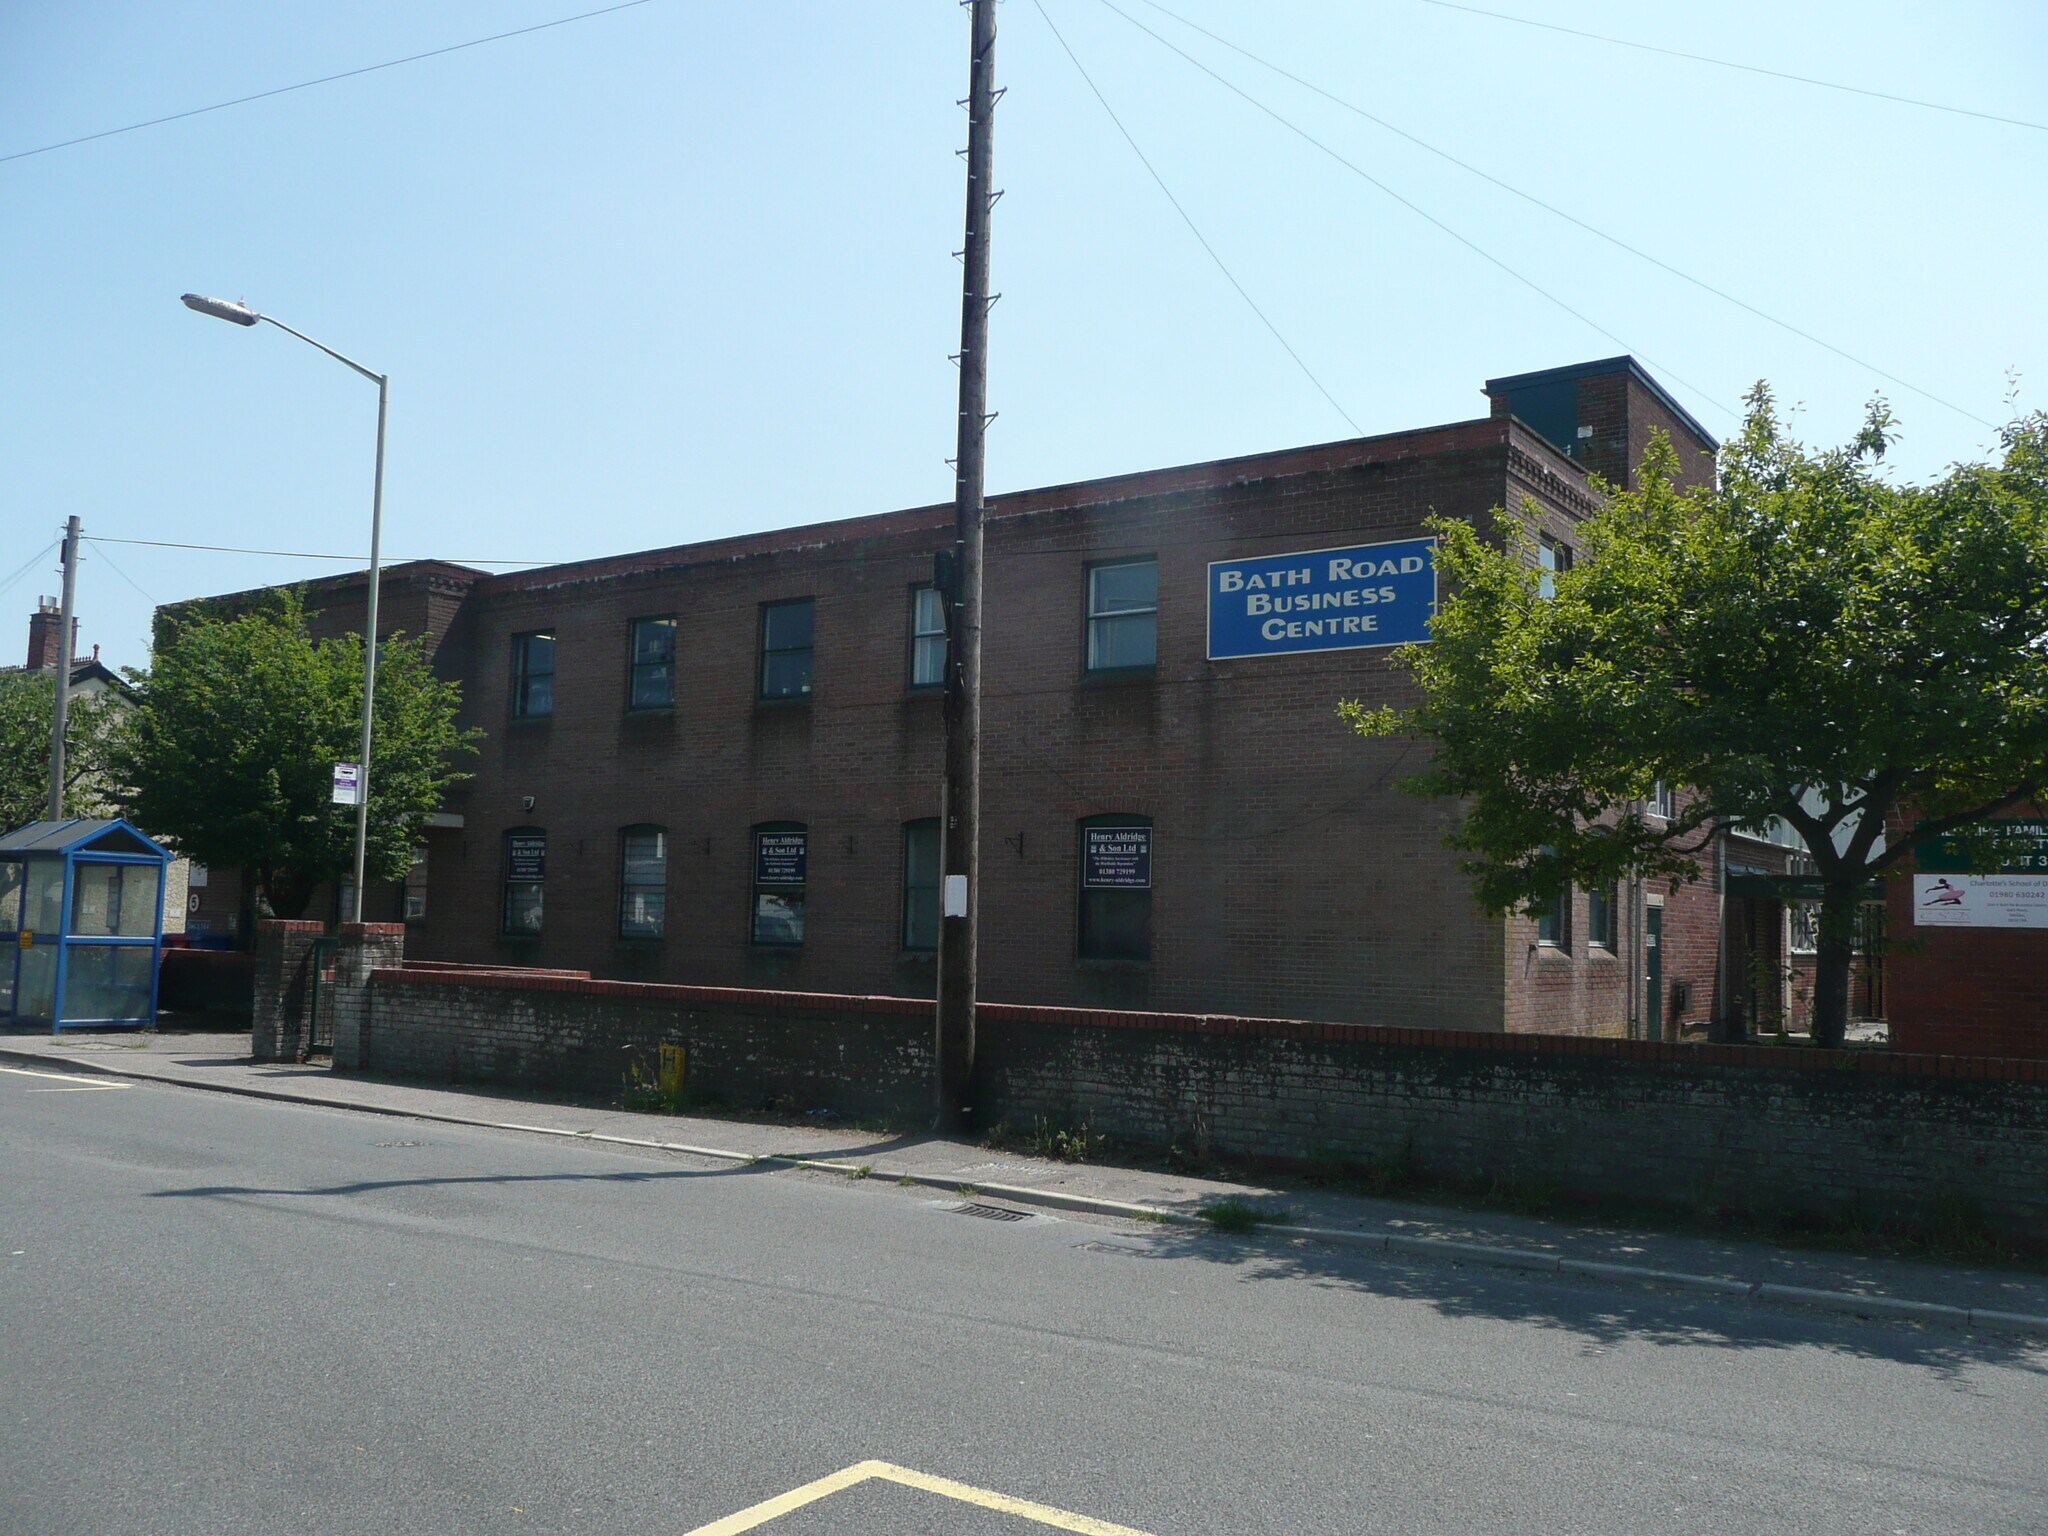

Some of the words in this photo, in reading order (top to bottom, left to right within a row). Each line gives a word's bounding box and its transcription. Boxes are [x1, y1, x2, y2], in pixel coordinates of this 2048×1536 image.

[1219, 567, 1311, 593] BATH
[1329, 556, 1424, 582] ROAD
[1247, 585, 1396, 616] BUSINESS
[1261, 614, 1378, 641] CENTRE
[1090, 832, 1113, 842] Henry
[1114, 832, 1147, 842] Aldridge
[1099, 844, 1107, 852] &
[1108, 844, 1122, 852] Son
[1123, 844, 1137, 852] Ltd
